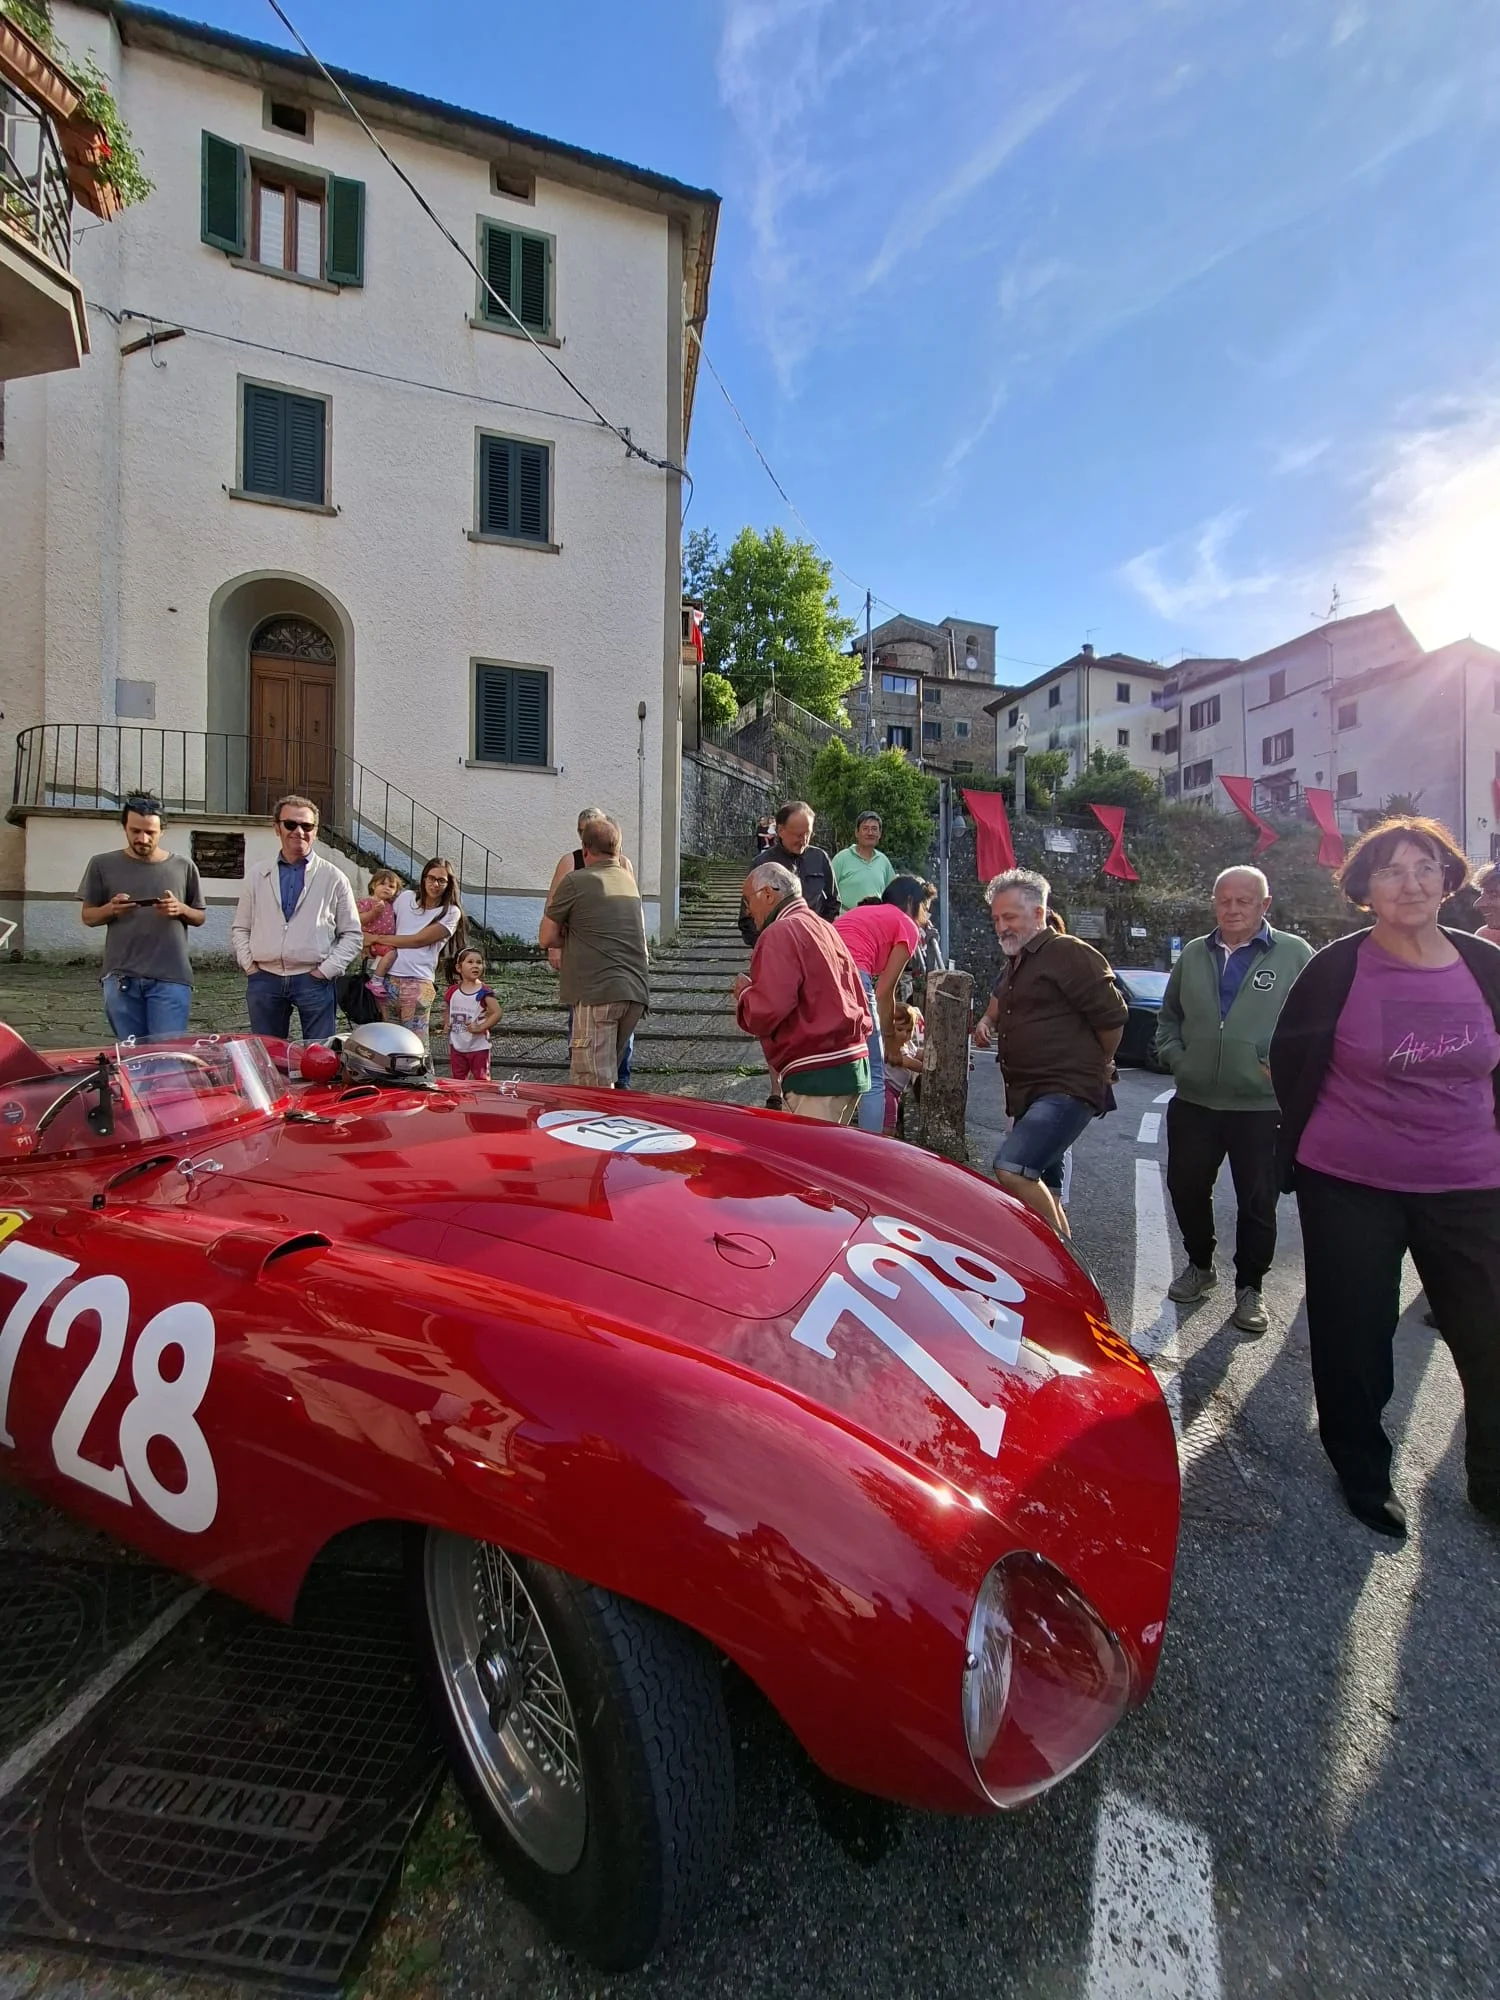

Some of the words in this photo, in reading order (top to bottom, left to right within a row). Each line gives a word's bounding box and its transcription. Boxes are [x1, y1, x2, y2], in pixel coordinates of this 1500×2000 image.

[1252, 969, 1277, 992] C
[577, 1119, 657, 1140] 133
[0, 1240, 218, 1533] 728
[790, 1216, 1026, 1458] 728
